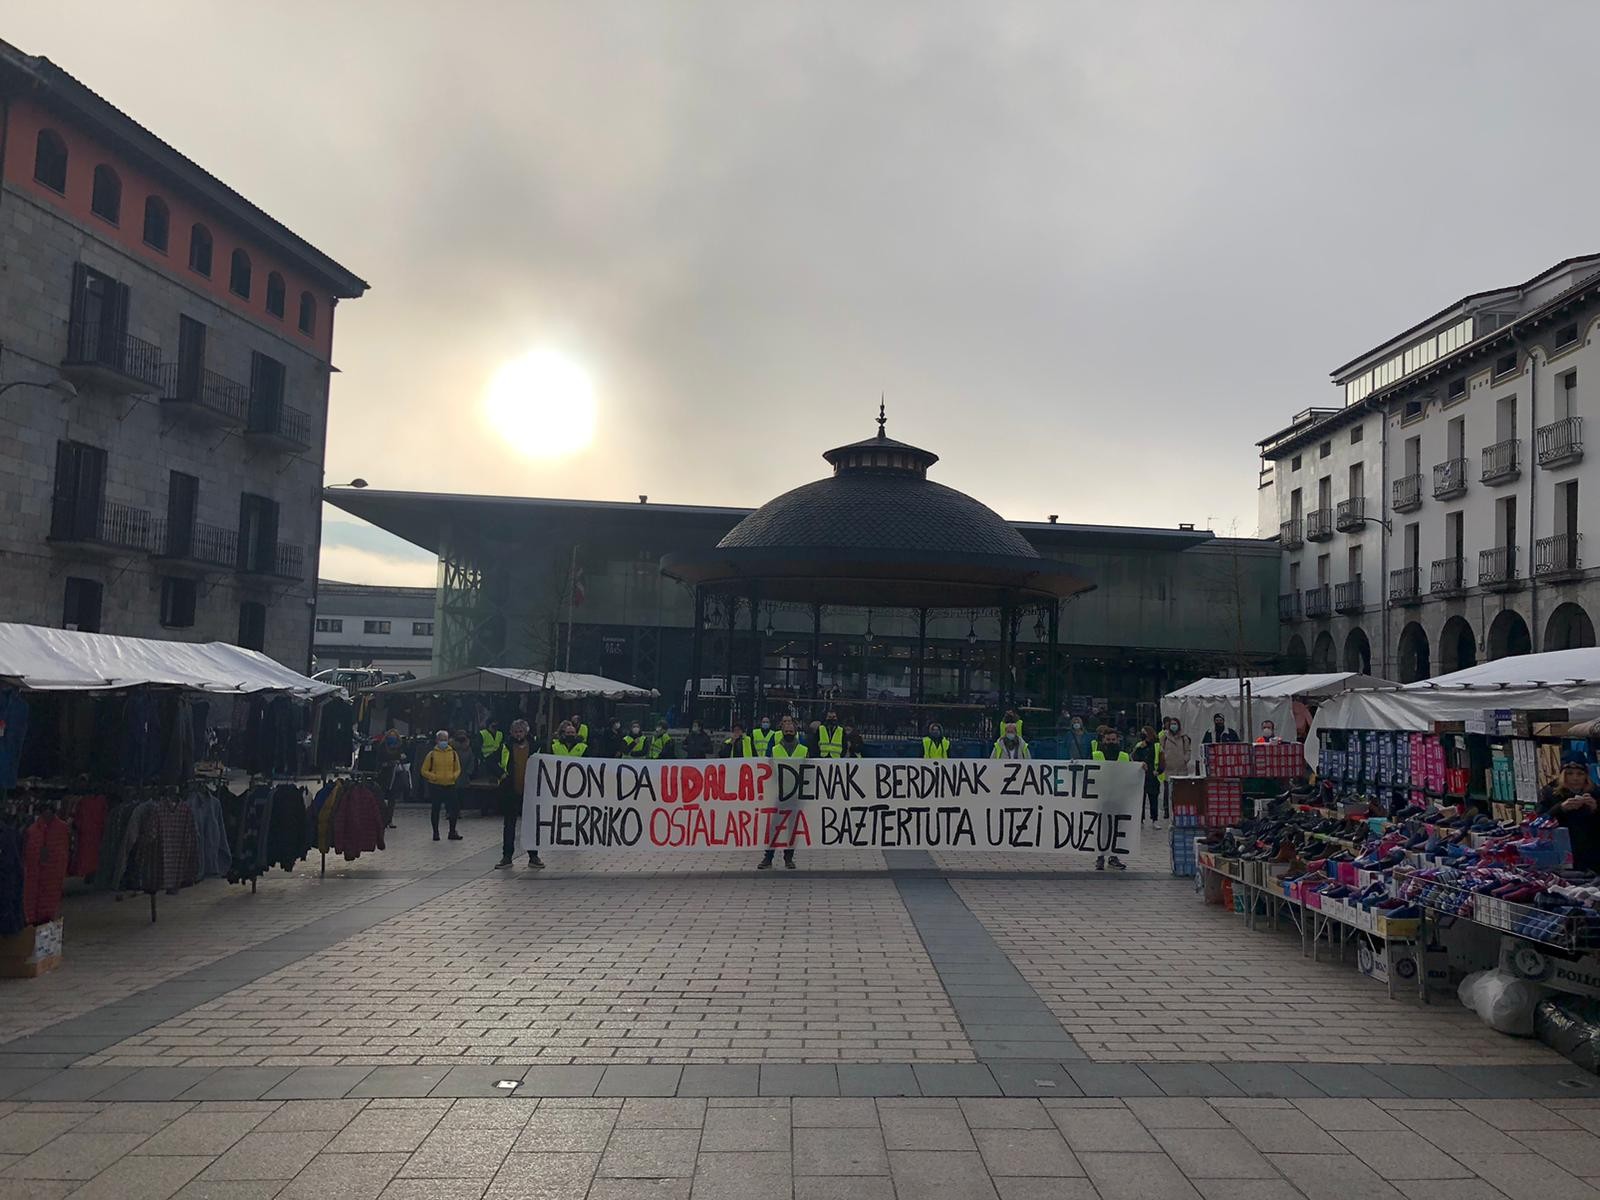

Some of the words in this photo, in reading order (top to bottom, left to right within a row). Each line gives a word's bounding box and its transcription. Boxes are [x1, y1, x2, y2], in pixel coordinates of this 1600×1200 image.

[536, 759, 606, 799] NON
[616, 763, 657, 802] DA
[660, 763, 773, 804] UDALA?
[777, 763, 866, 801] DENAK
[1000, 763, 1101, 799] ZARETE
[821, 804, 977, 847] BAZTERTUTA
[1053, 809, 1132, 854] DUZUE
